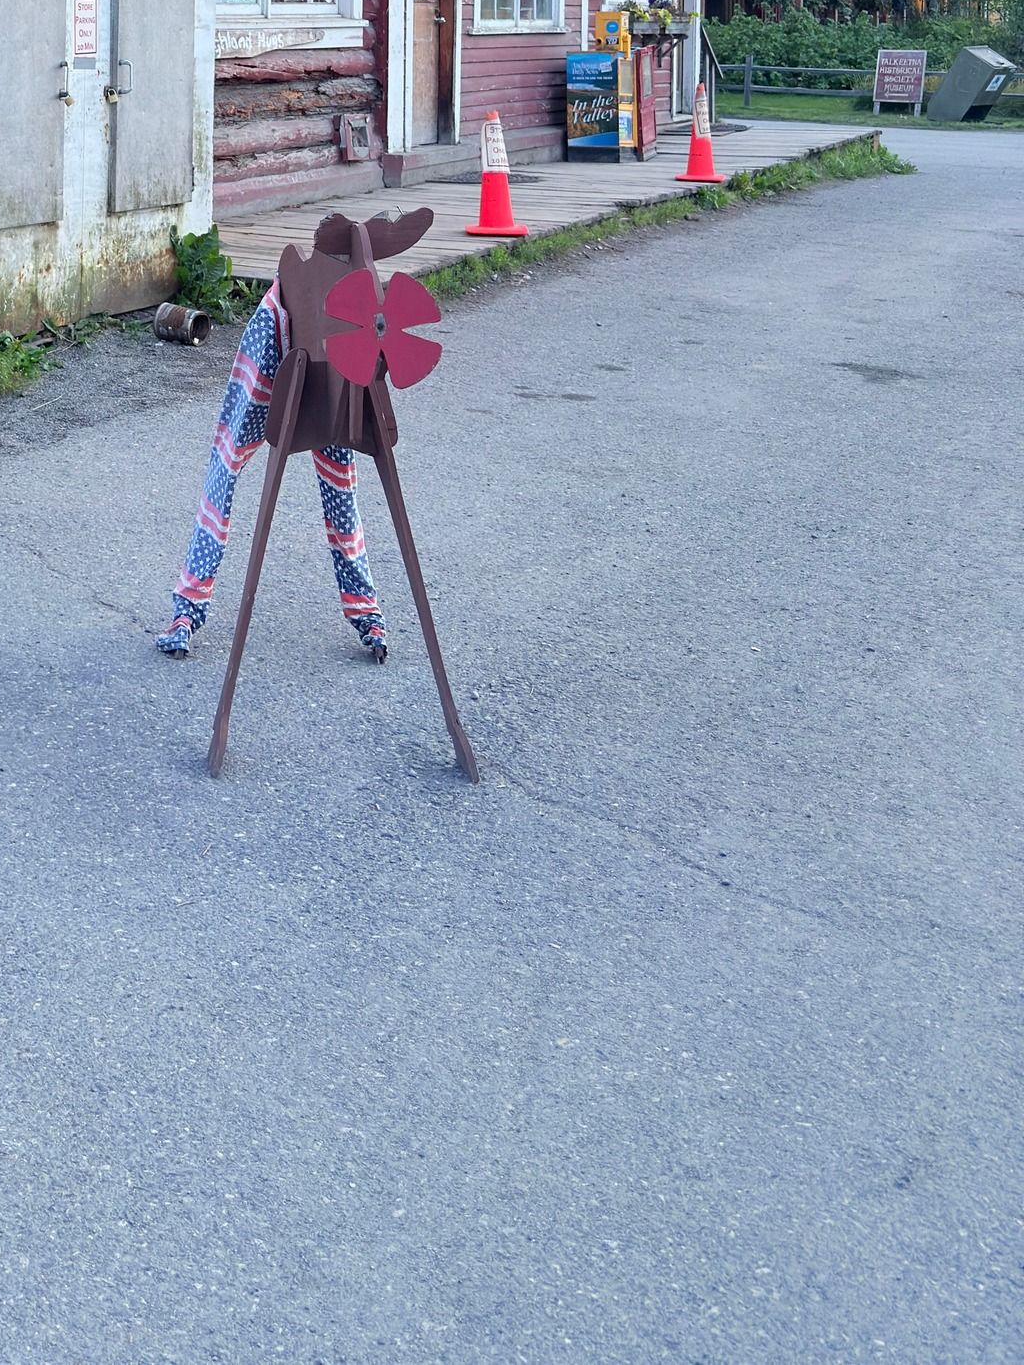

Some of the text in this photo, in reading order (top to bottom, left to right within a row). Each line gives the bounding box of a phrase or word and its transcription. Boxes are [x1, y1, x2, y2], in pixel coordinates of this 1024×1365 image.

[76, 16, 96, 24] PARKING
[79, 29, 92, 38] ONLY
[881, 58, 922, 66] TALKEETNA
[879, 67, 921, 75] HISTORICAL
[884, 84, 914, 92] MUSEUM
[573, 95, 614, 112] In the
[573, 107, 617, 124] Valley
